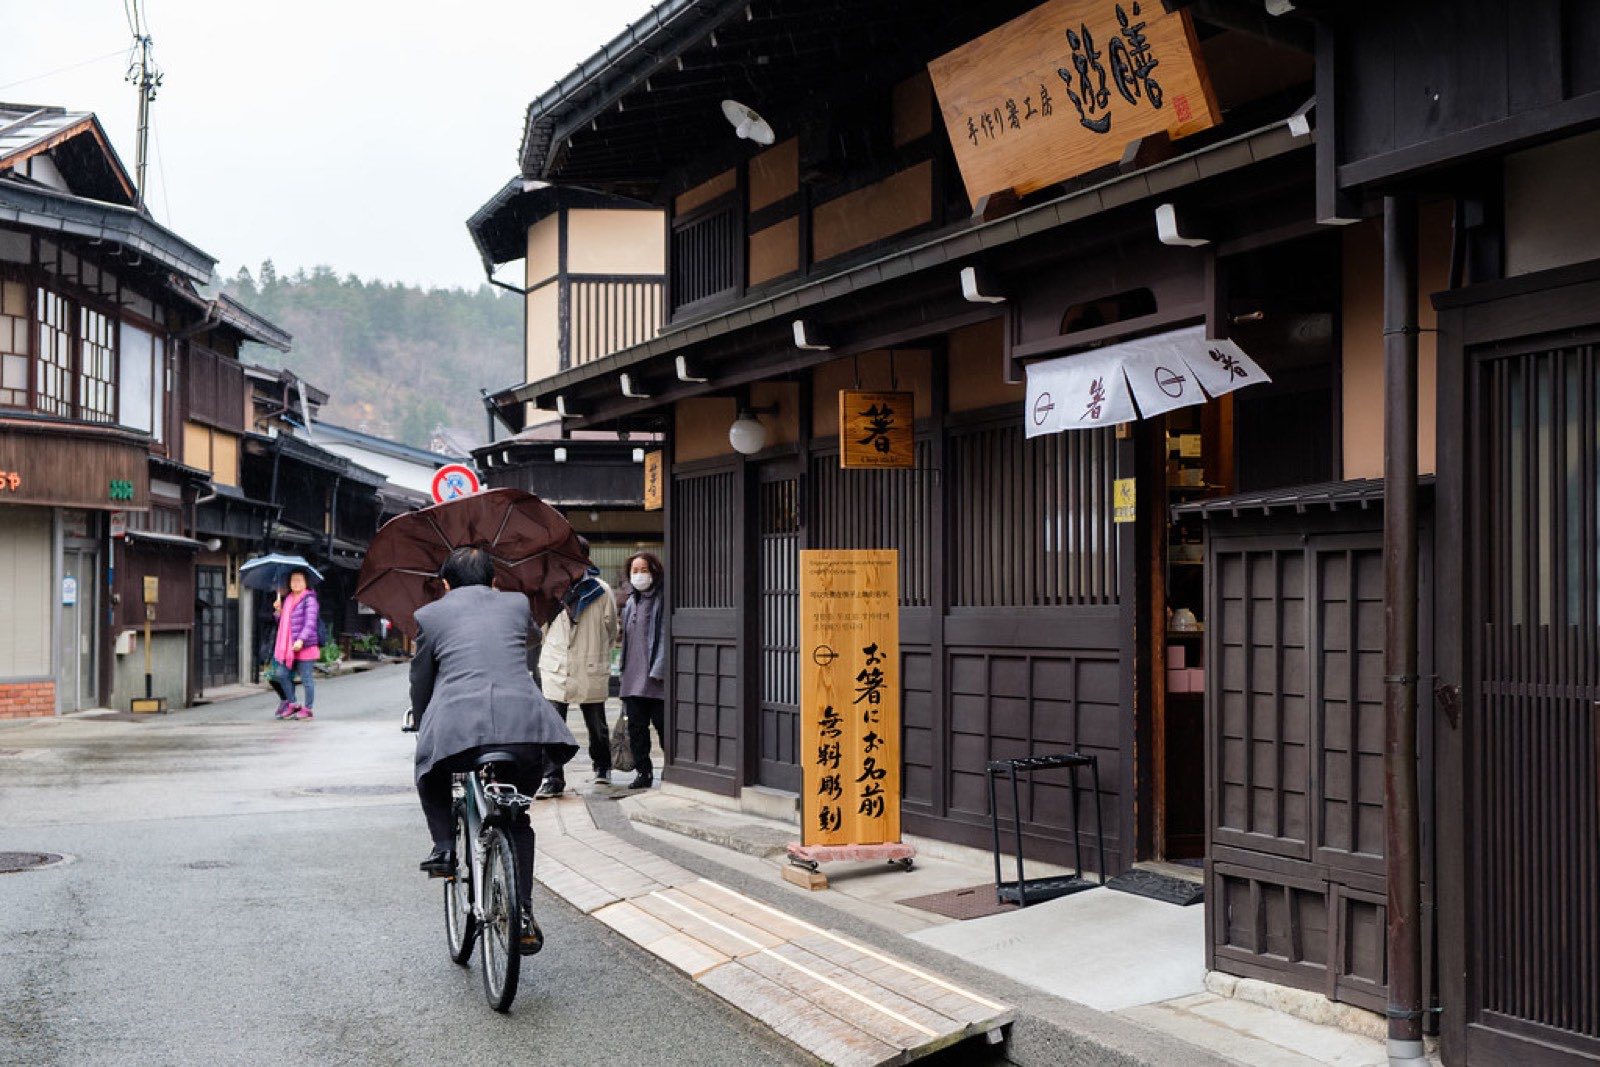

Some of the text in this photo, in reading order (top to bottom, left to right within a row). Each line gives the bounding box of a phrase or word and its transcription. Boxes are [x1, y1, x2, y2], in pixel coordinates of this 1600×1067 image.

[966, 84, 1053, 147] 手作り箸工房
[1208, 347, 1248, 383] 箸
[1079, 376, 1106, 421] 箸
[852, 642, 889, 820] お箸にお名前
[816, 706, 844, 833] 無料彫刻
